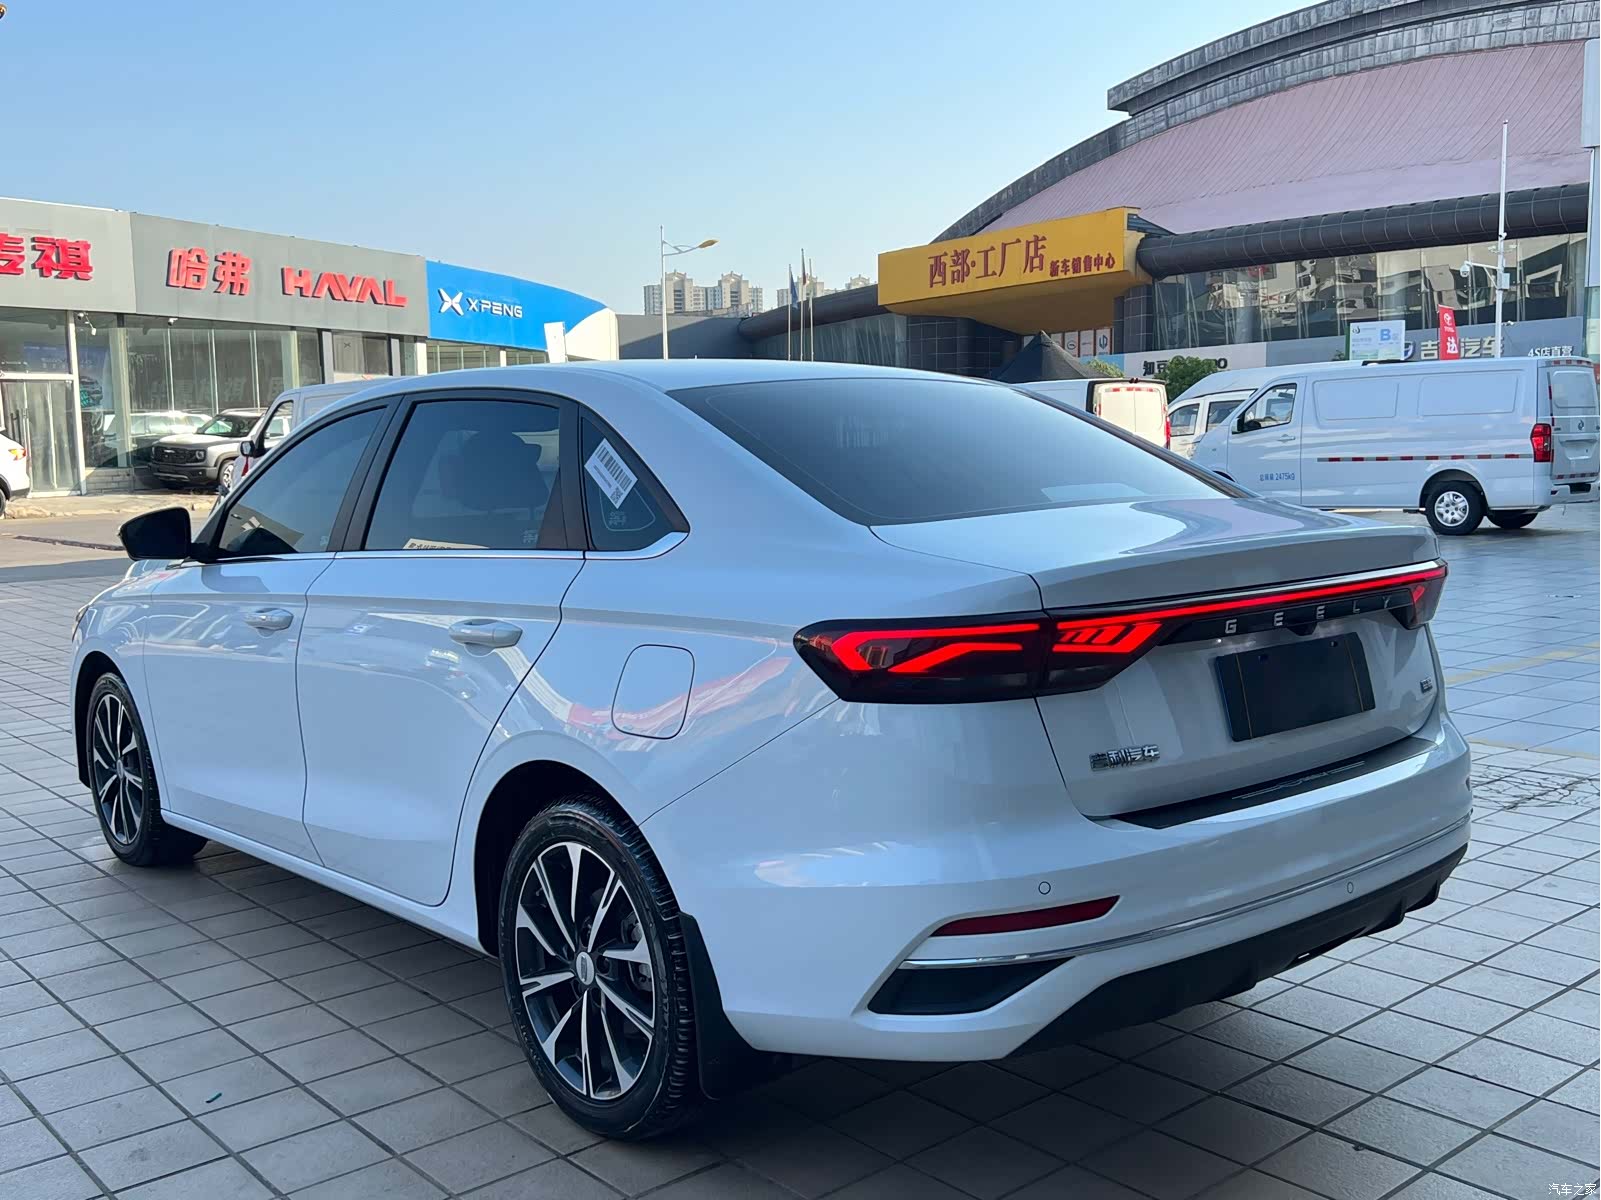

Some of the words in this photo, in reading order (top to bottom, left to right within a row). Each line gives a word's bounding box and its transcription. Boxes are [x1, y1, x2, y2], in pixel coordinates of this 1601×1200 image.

[167, 247, 252, 295] 哈弗
[281, 265, 408, 307] HAVAL
[467, 298, 523, 318] XPENG
[1420, 336, 1504, 360] 吉汽车
[1224, 595, 1391, 634] GEELY
